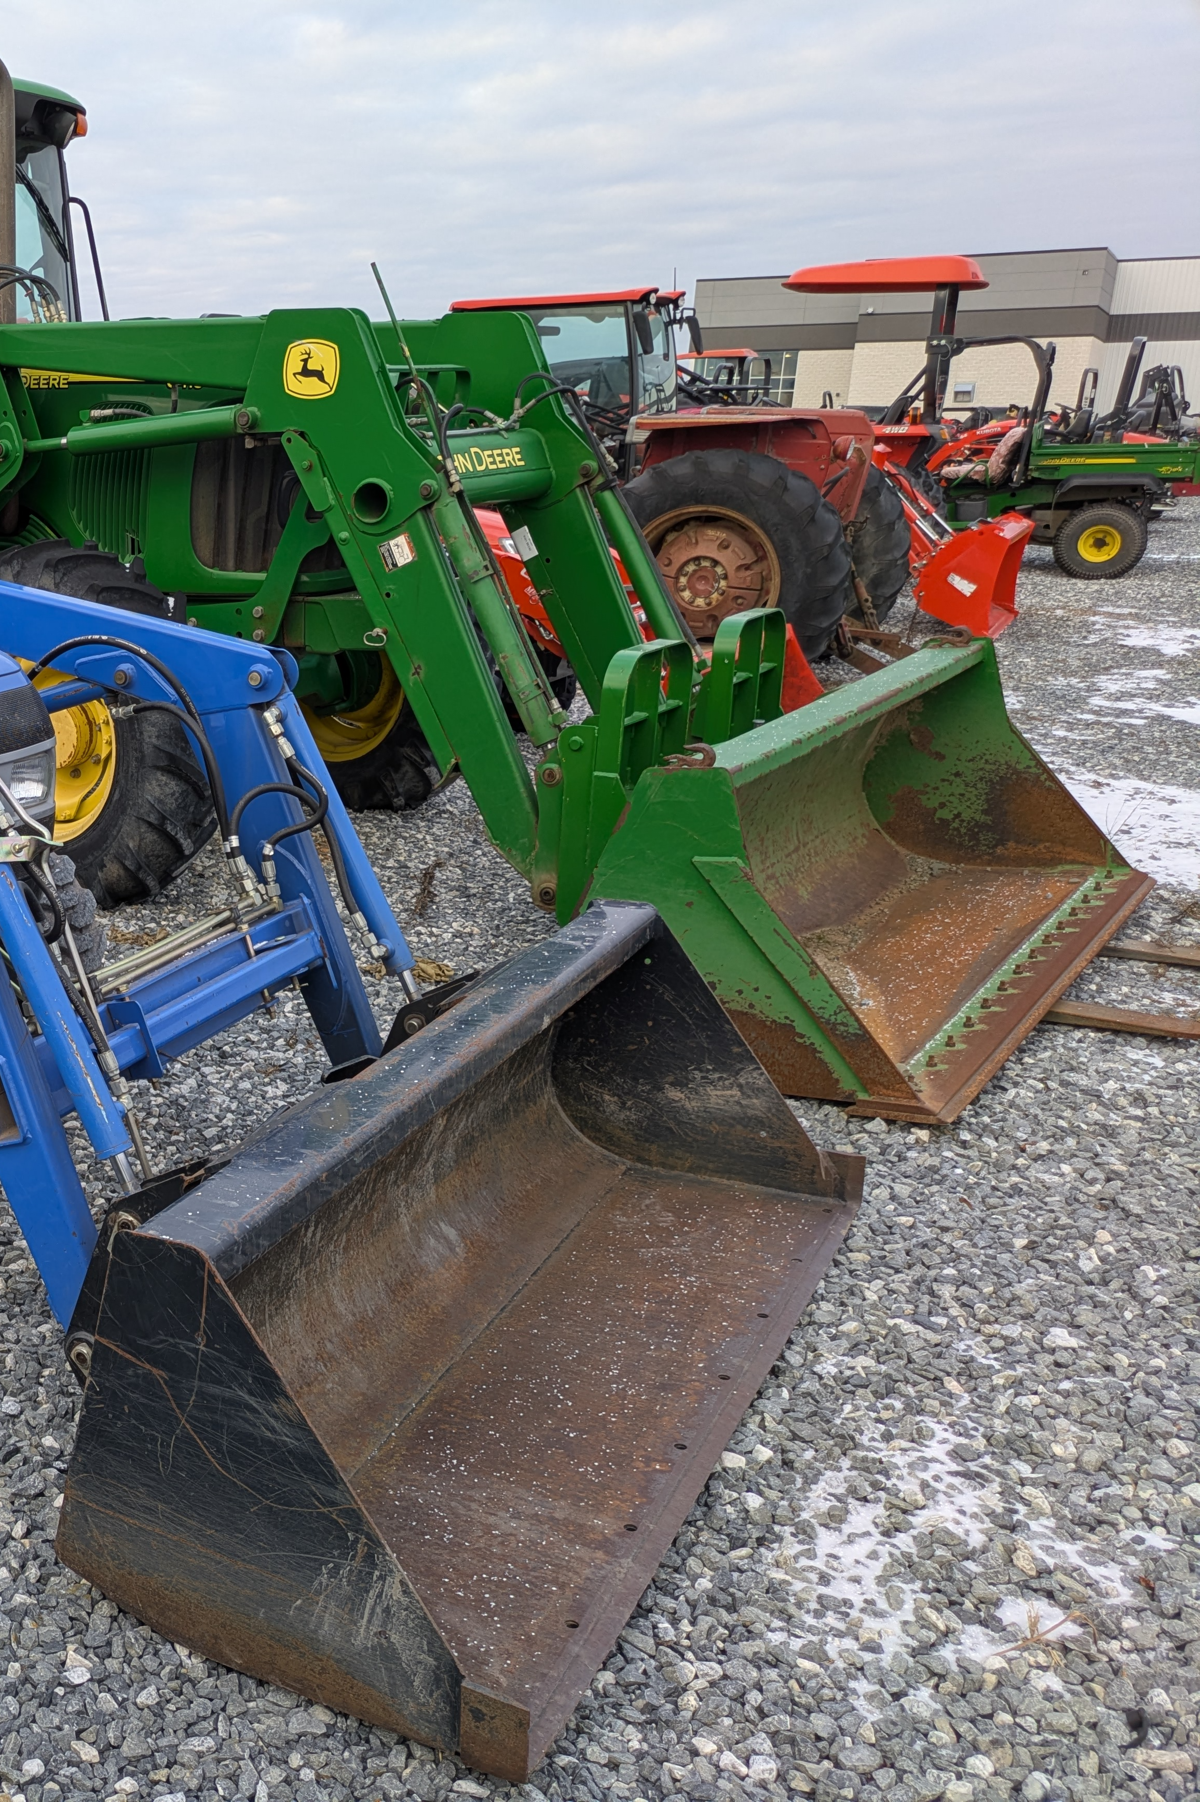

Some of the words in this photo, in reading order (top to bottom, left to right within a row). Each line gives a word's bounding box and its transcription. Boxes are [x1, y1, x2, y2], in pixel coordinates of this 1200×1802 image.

[21, 375, 70, 389] DEERE
[976, 427, 1002, 436] KUBOTA
[469, 447, 526, 471] DEERE
